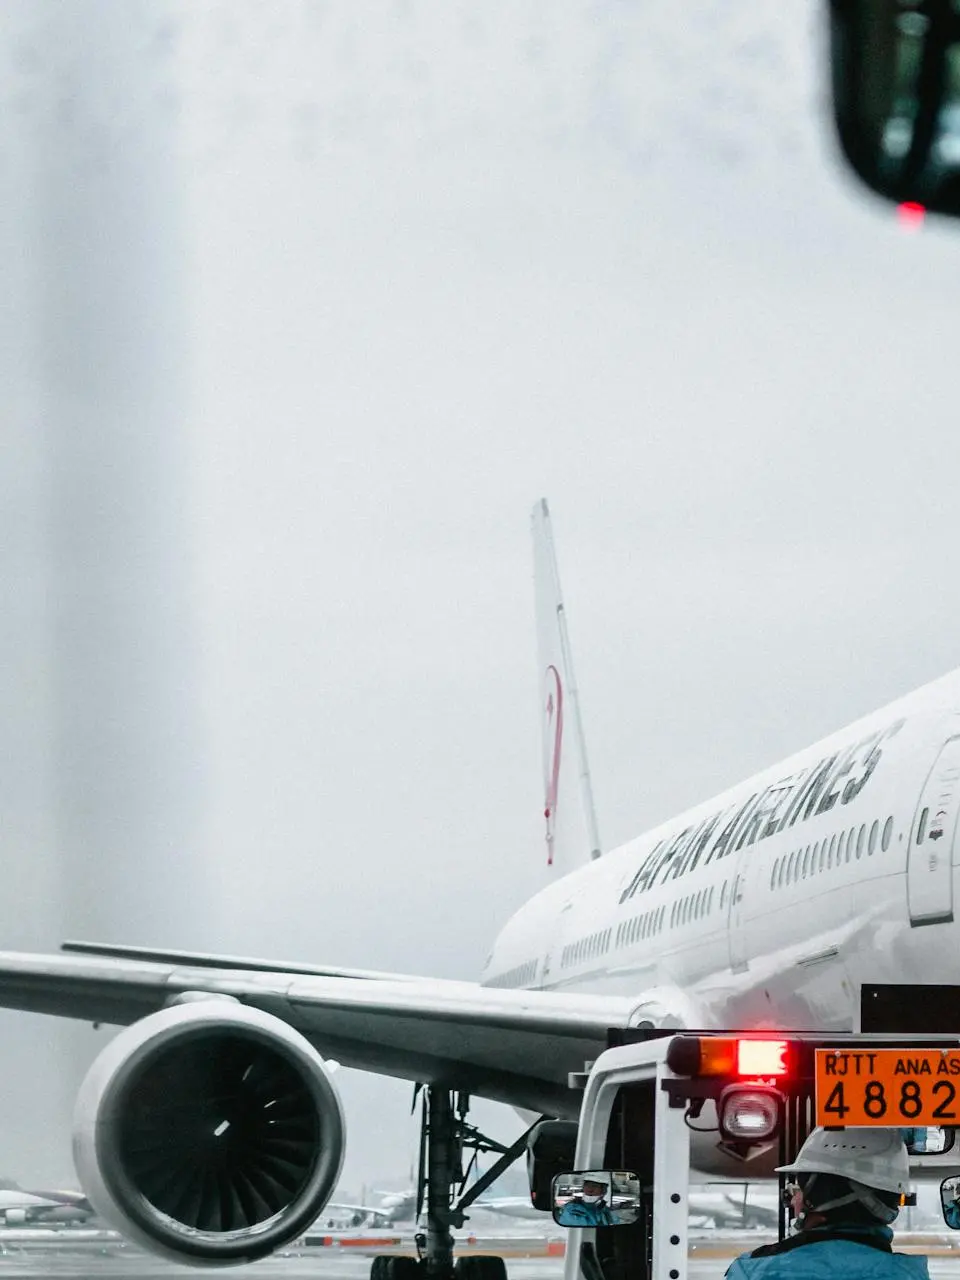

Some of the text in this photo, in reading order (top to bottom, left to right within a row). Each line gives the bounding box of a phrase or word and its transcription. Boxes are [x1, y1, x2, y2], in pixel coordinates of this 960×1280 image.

[618, 717, 907, 905] JAPAN AIRLINES
[825, 1053, 877, 1076] RJTT
[894, 1058, 932, 1076] ANA
[823, 1080, 957, 1120] 4882
